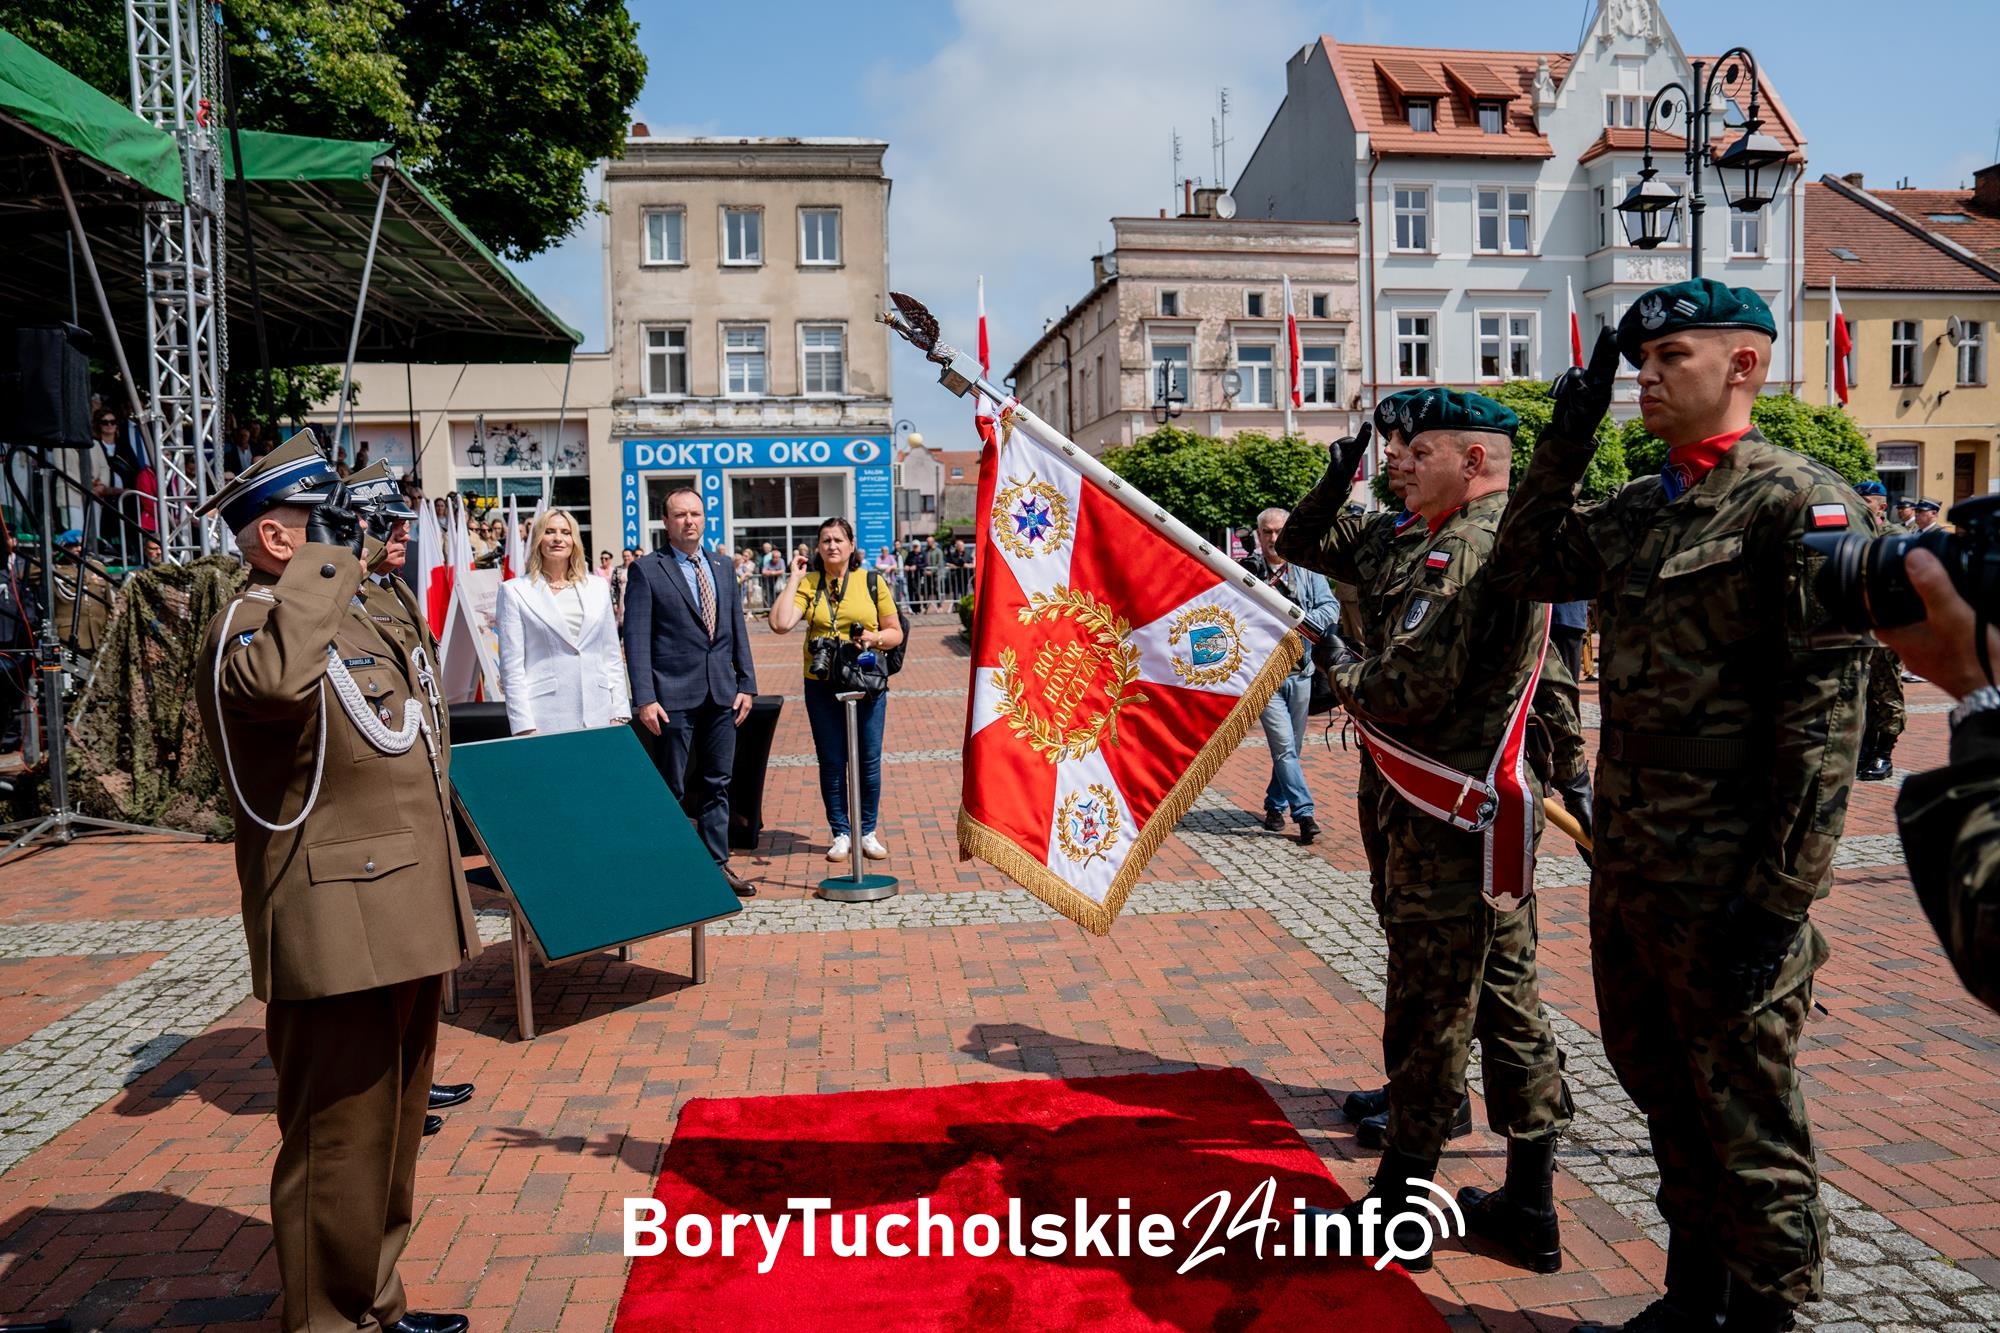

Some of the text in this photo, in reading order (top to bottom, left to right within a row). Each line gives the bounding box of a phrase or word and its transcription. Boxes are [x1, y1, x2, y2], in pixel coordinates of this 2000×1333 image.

[635, 441, 831, 466] DOKTOR OKO
[1042, 640, 1085, 705] HONOR
[1053, 643, 1109, 728] OJCZYZNA
